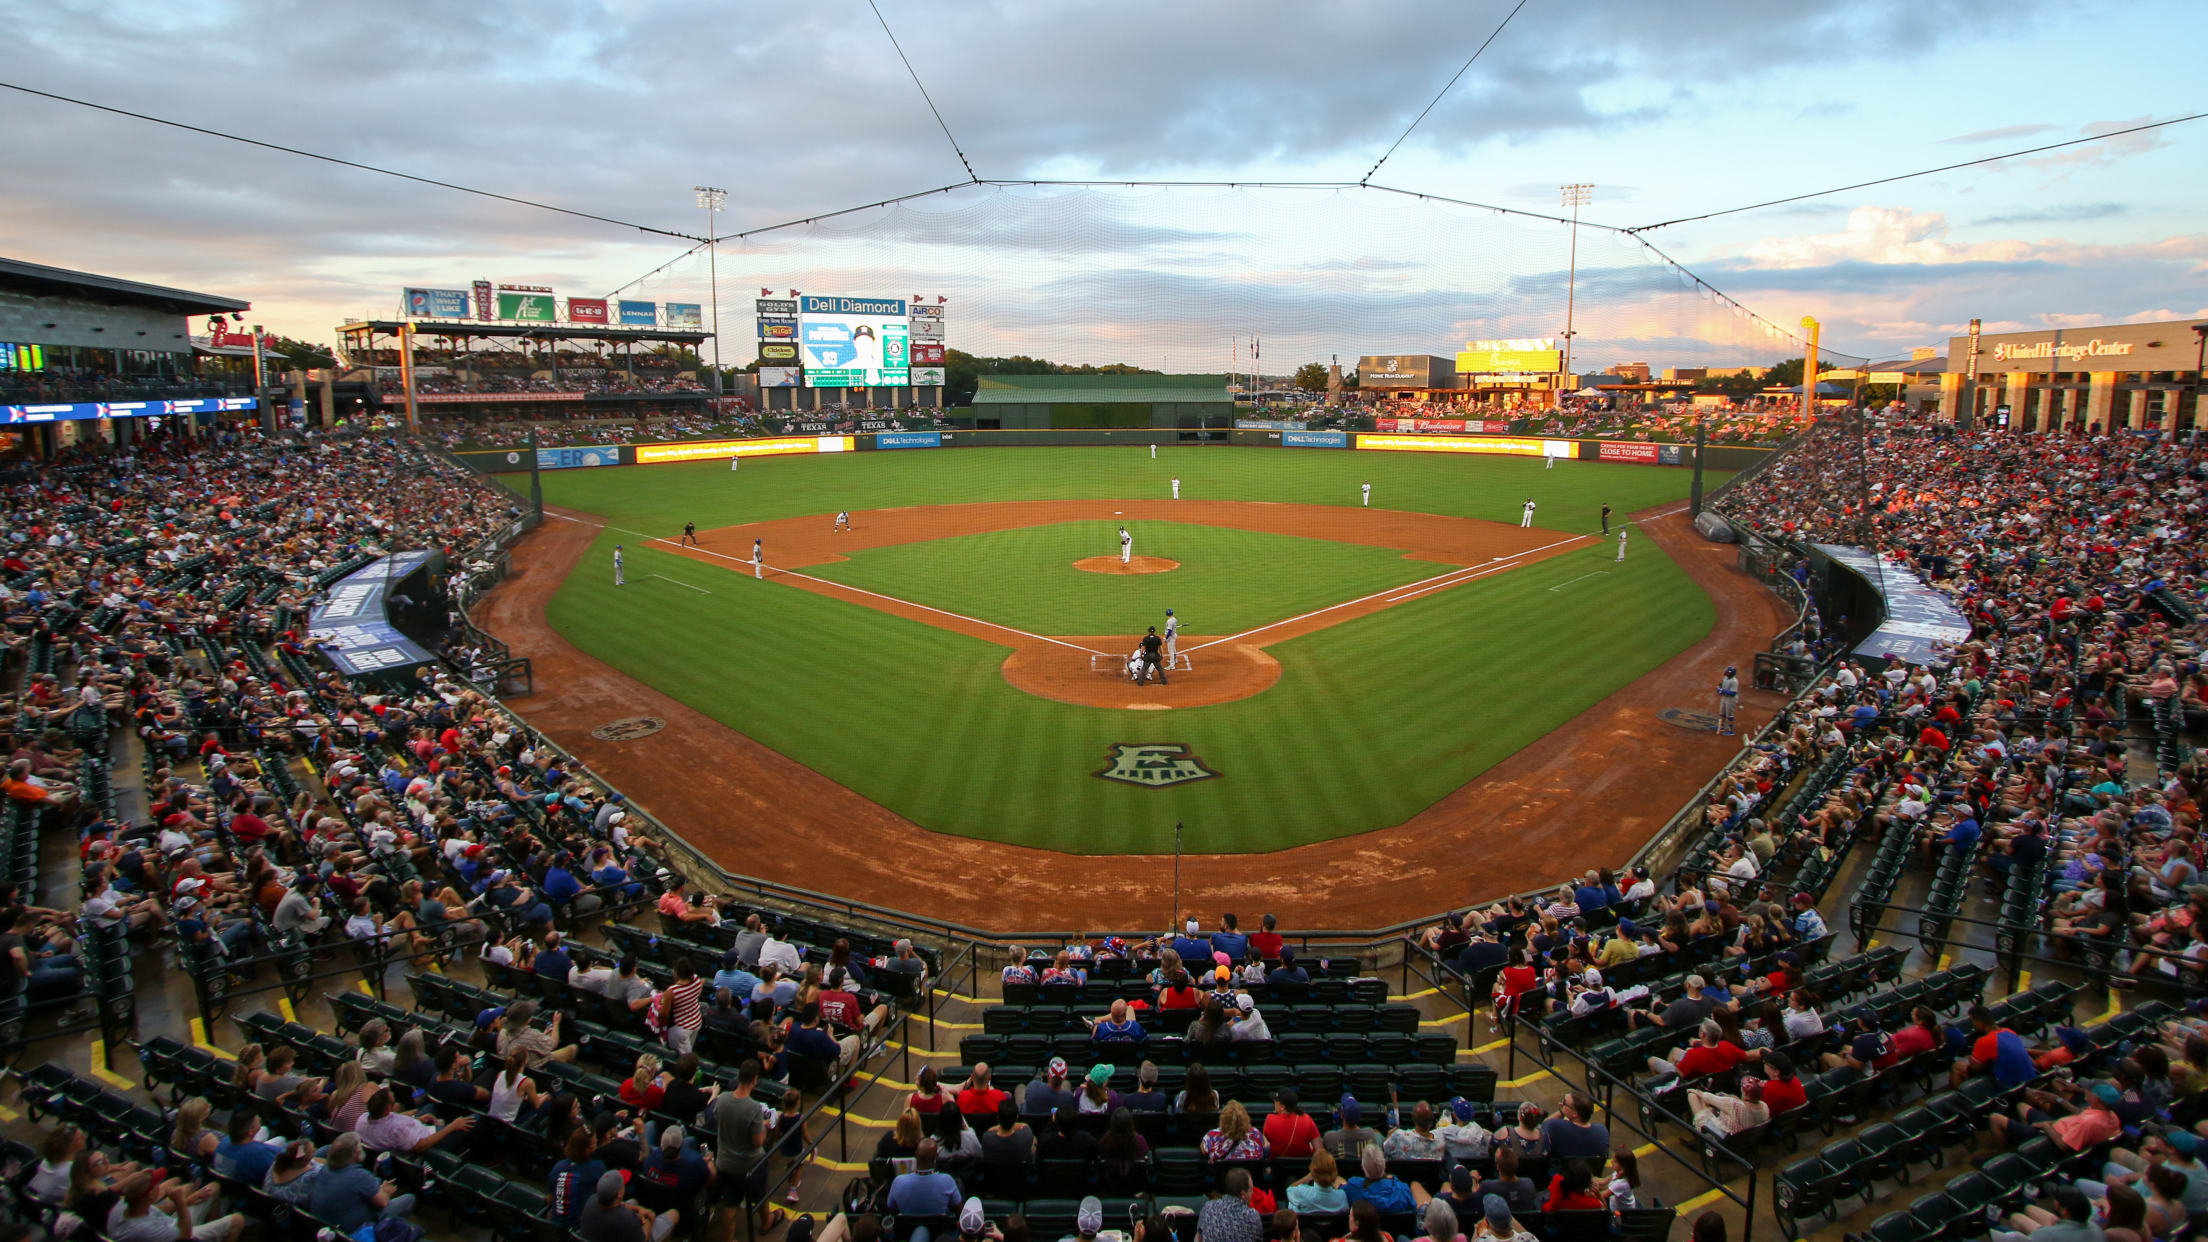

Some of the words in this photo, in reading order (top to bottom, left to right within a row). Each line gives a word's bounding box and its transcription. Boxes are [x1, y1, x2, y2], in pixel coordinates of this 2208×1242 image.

[434, 290, 464, 299] THAT'S
[435, 299, 460, 307] WHAT
[809, 298, 836, 312] Dell
[841, 299, 899, 314] Diamond
[442, 305, 460, 313] LIKE
[2006, 343, 2040, 359] United
[2040, 341, 2088, 361] Heritage
[2088, 339, 2135, 356] Center
[861, 421, 886, 429] TEXAS
[1418, 420, 1462, 430] Budweiser
[882, 437, 901, 445] DELL
[900, 436, 935, 445] Technologies
[1288, 435, 1306, 443] DELL
[561, 450, 582, 465] ER
